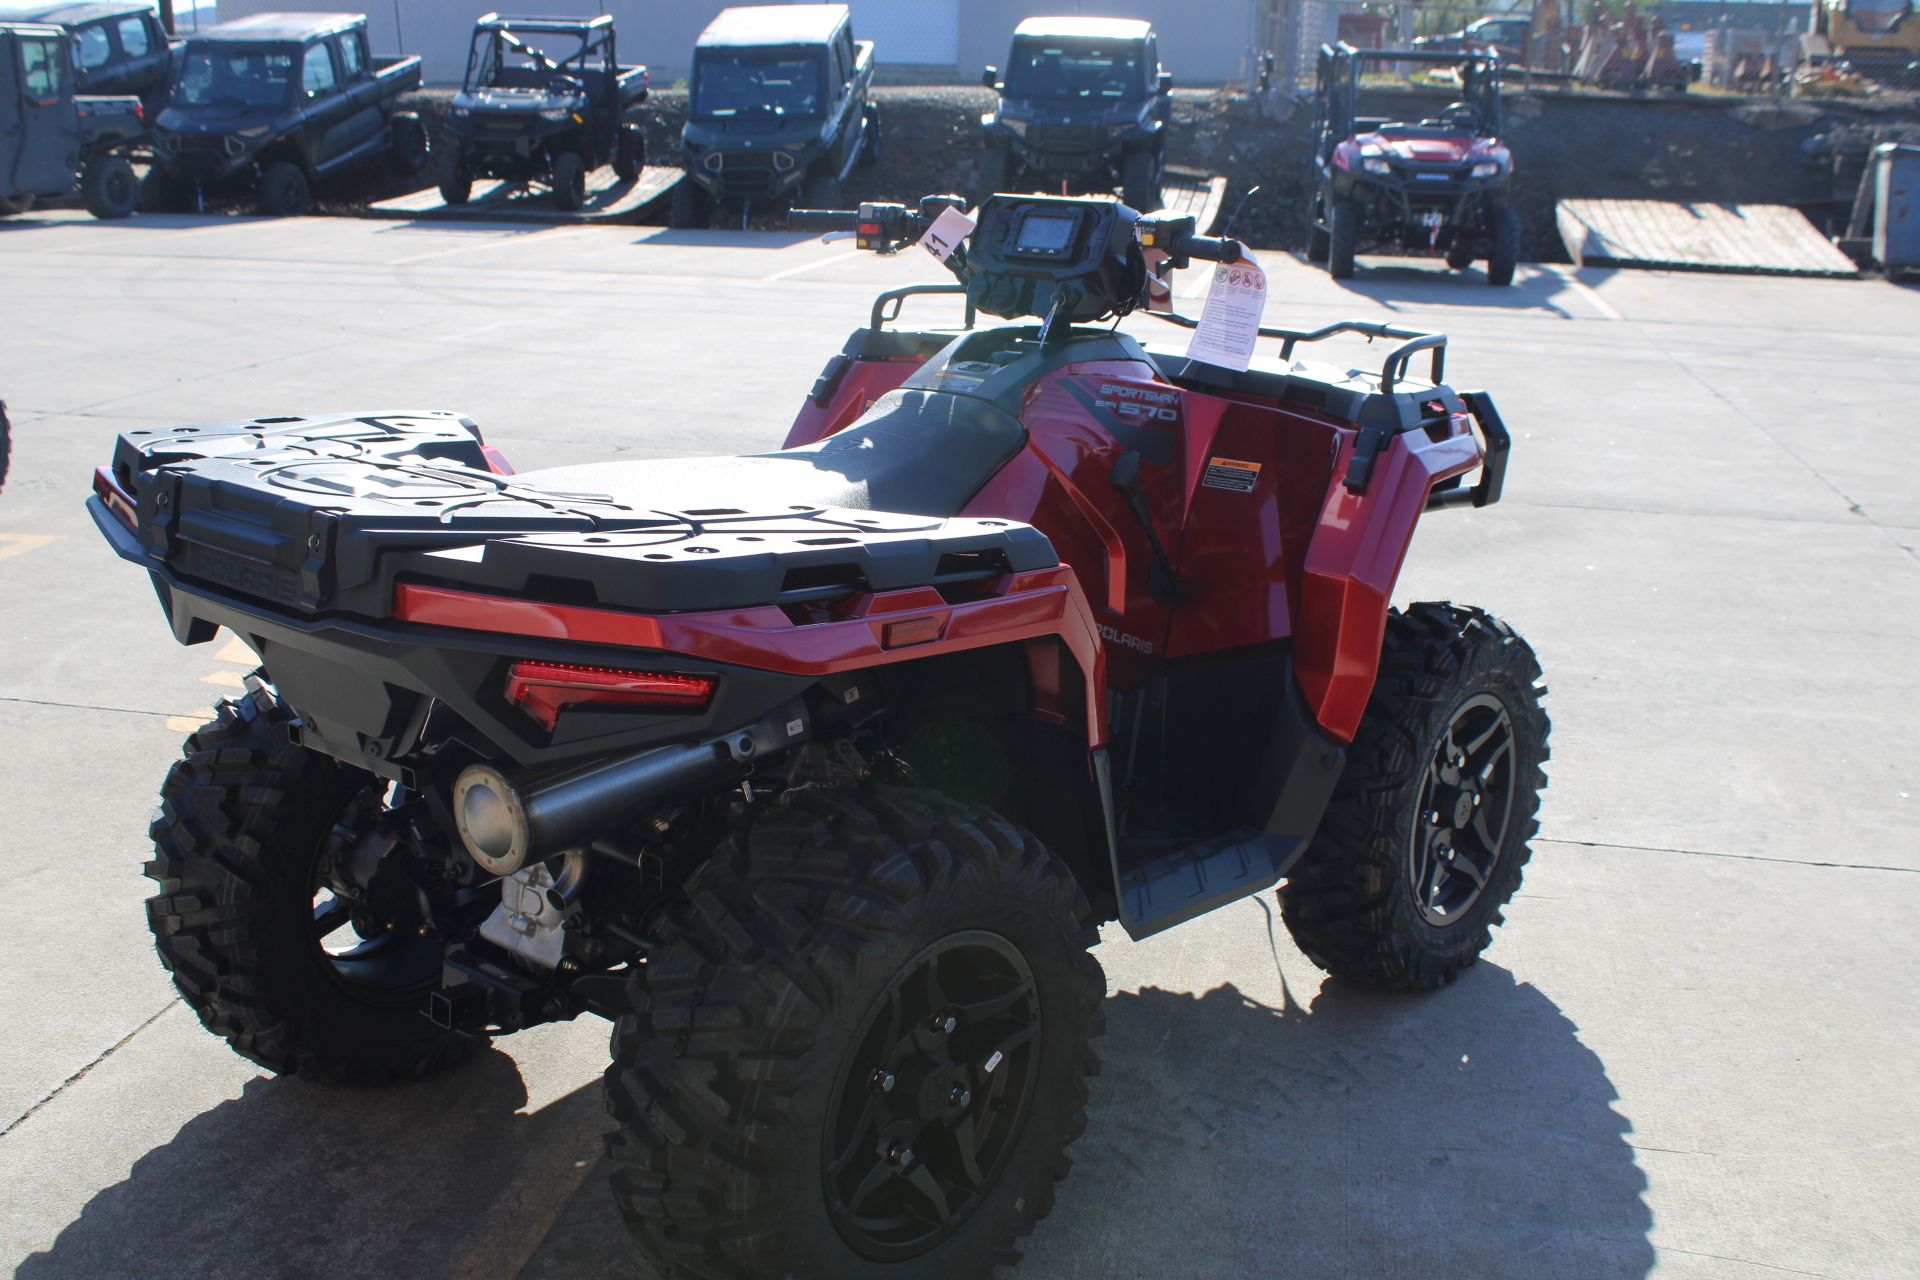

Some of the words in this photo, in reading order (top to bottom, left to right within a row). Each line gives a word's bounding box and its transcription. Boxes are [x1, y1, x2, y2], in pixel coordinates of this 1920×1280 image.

[925, 233, 949, 257] 41
[1100, 383, 1180, 405] SPORTSMAN
[1119, 401, 1177, 421] 570
